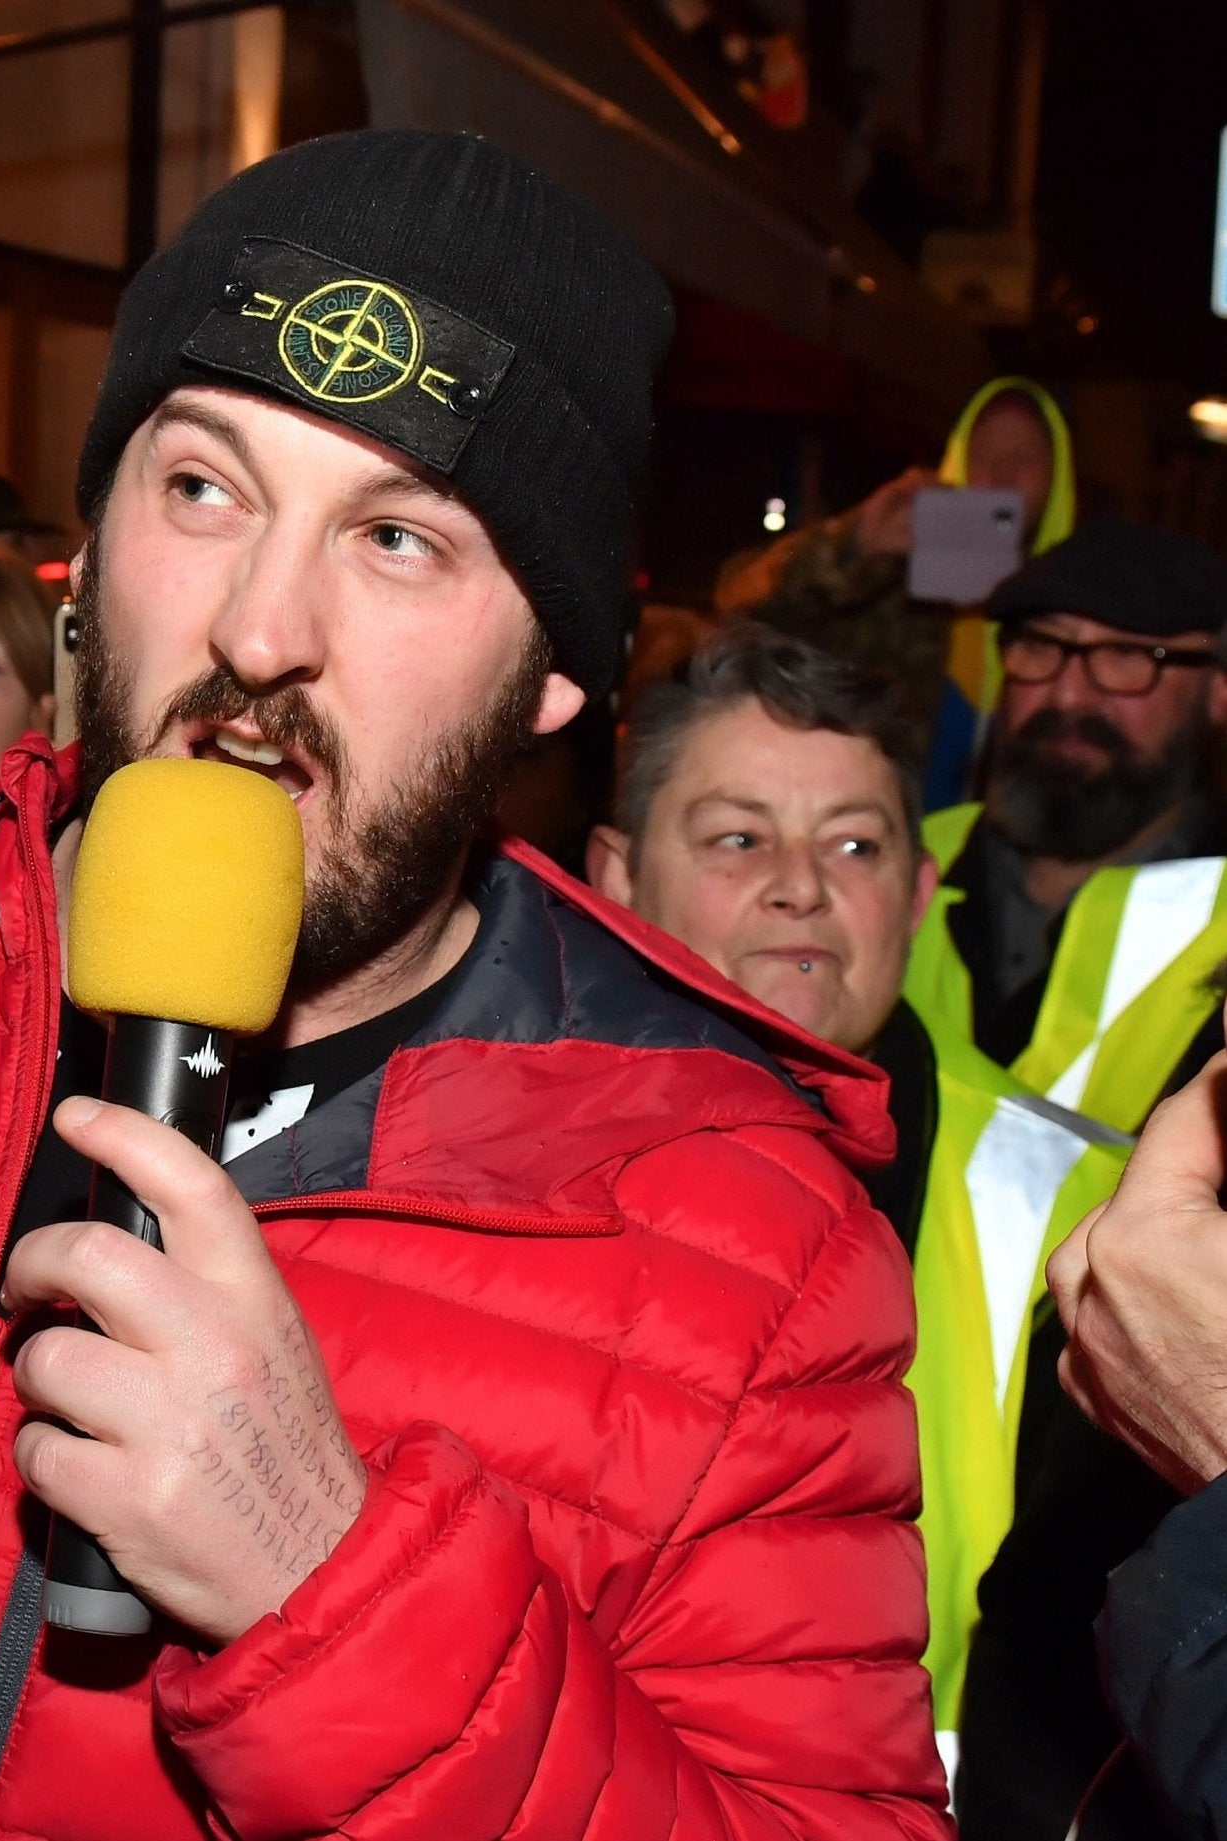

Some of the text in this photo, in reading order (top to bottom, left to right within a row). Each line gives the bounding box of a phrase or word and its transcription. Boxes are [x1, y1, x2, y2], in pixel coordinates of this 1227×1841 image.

[305, 290, 409, 359] STONE ISLAND
[331, 364, 391, 394] STONE
